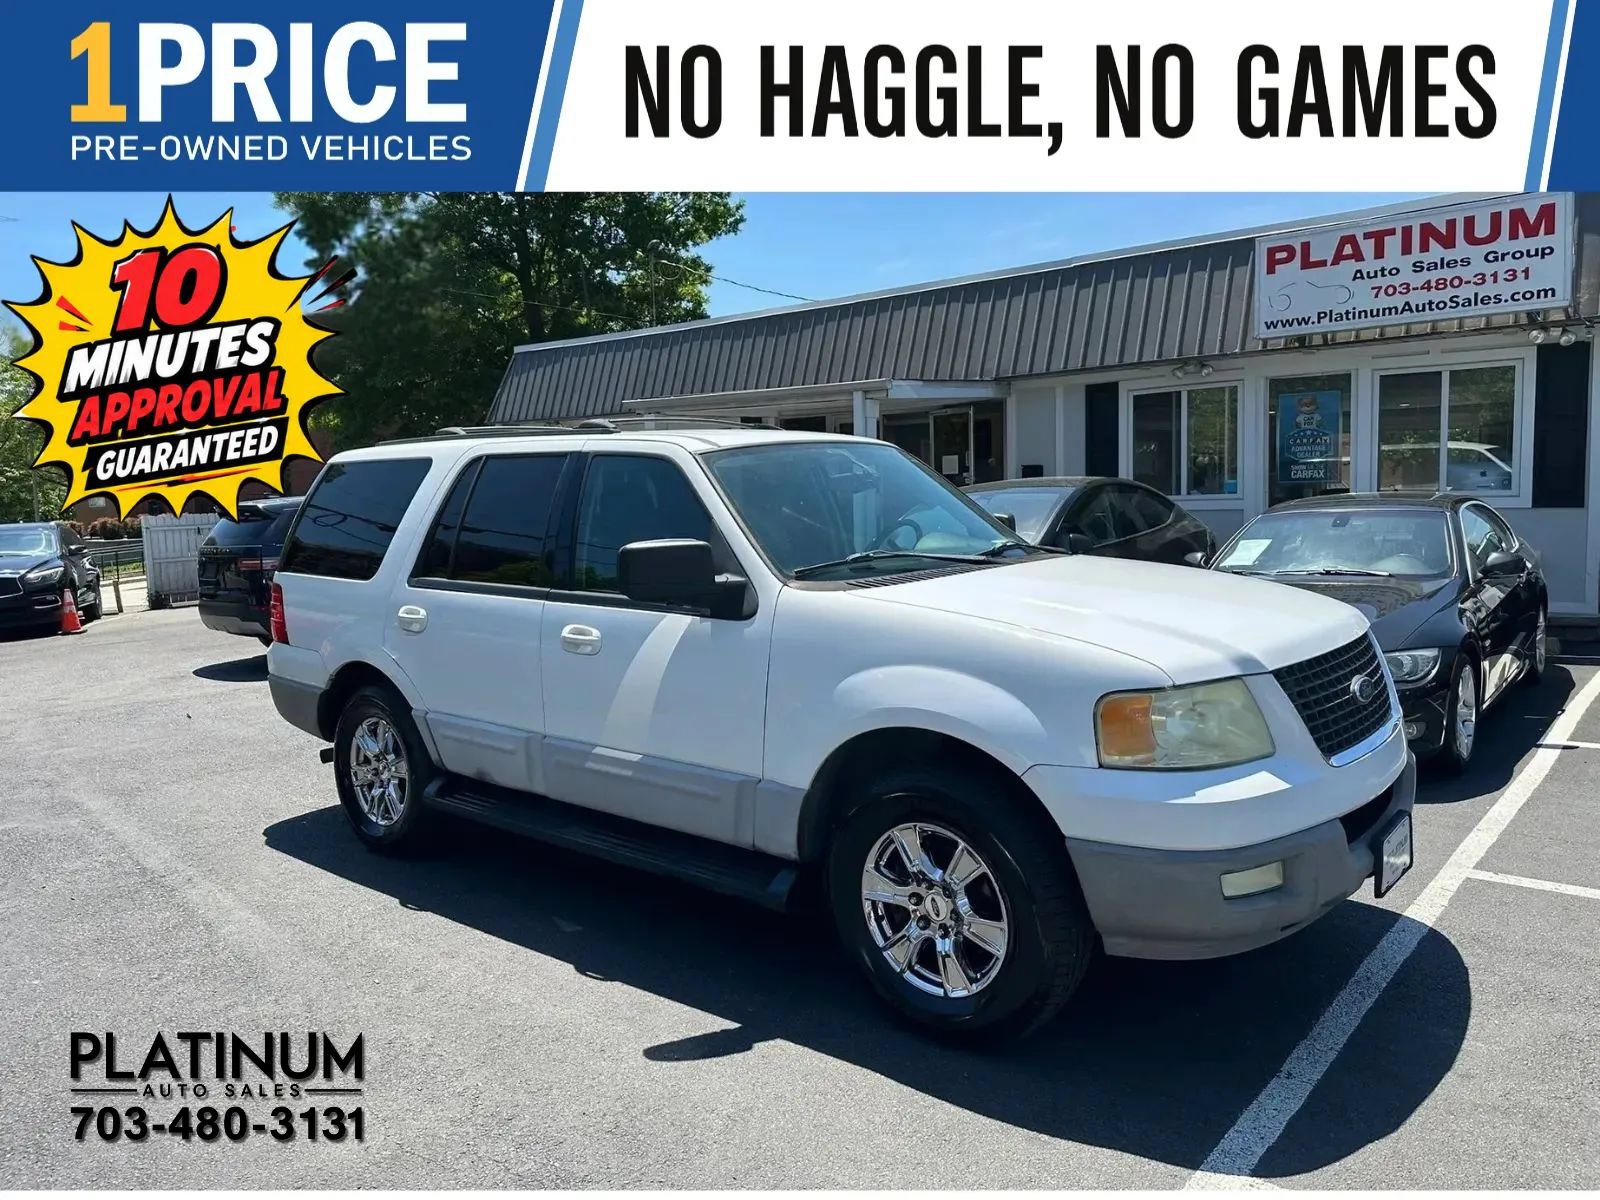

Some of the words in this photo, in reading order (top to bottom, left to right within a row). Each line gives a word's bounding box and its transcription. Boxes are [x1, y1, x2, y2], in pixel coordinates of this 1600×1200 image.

[1266, 202, 1556, 275] PLATINUM
[1351, 266, 1401, 282] Auto
[1412, 256, 1472, 273] Sales
[1483, 245, 1555, 264] Group
[1370, 266, 1531, 299] 703-480-3131
[1264, 287, 1556, 331] www.PlatinumAutoSales.com
[1291, 469, 1325, 479] CARFAX
